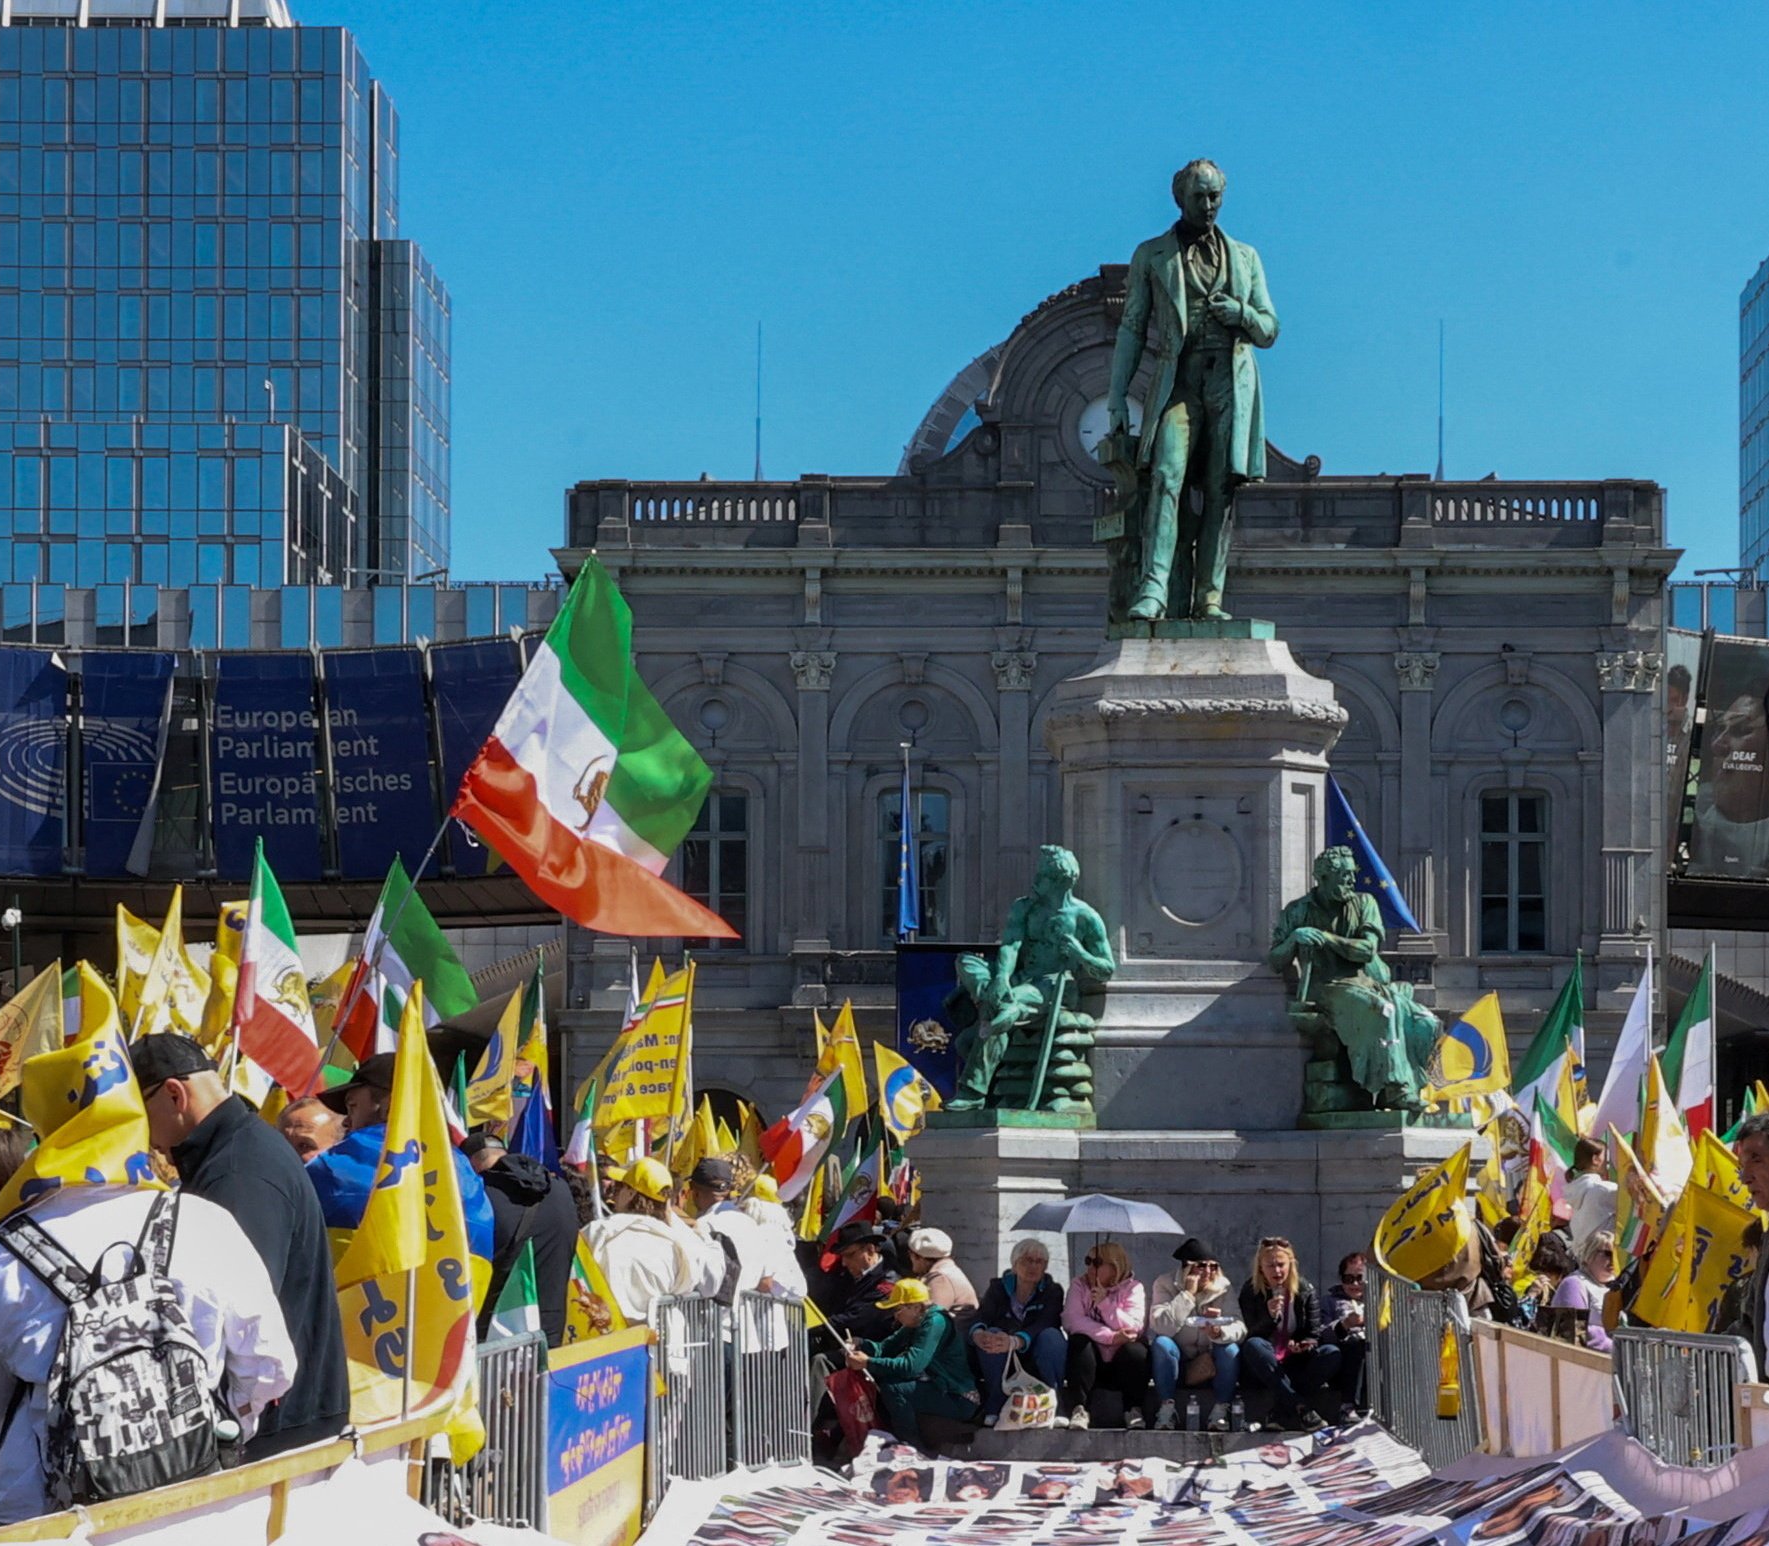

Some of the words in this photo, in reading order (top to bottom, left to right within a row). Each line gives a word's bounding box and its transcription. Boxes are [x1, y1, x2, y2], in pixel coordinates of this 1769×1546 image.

[216, 706, 358, 732] European
[217, 735, 380, 759] Parliament
[1732, 750, 1757, 762] DEAF
[219, 767, 413, 800] Europäisches
[220, 801, 379, 825] Parlament
